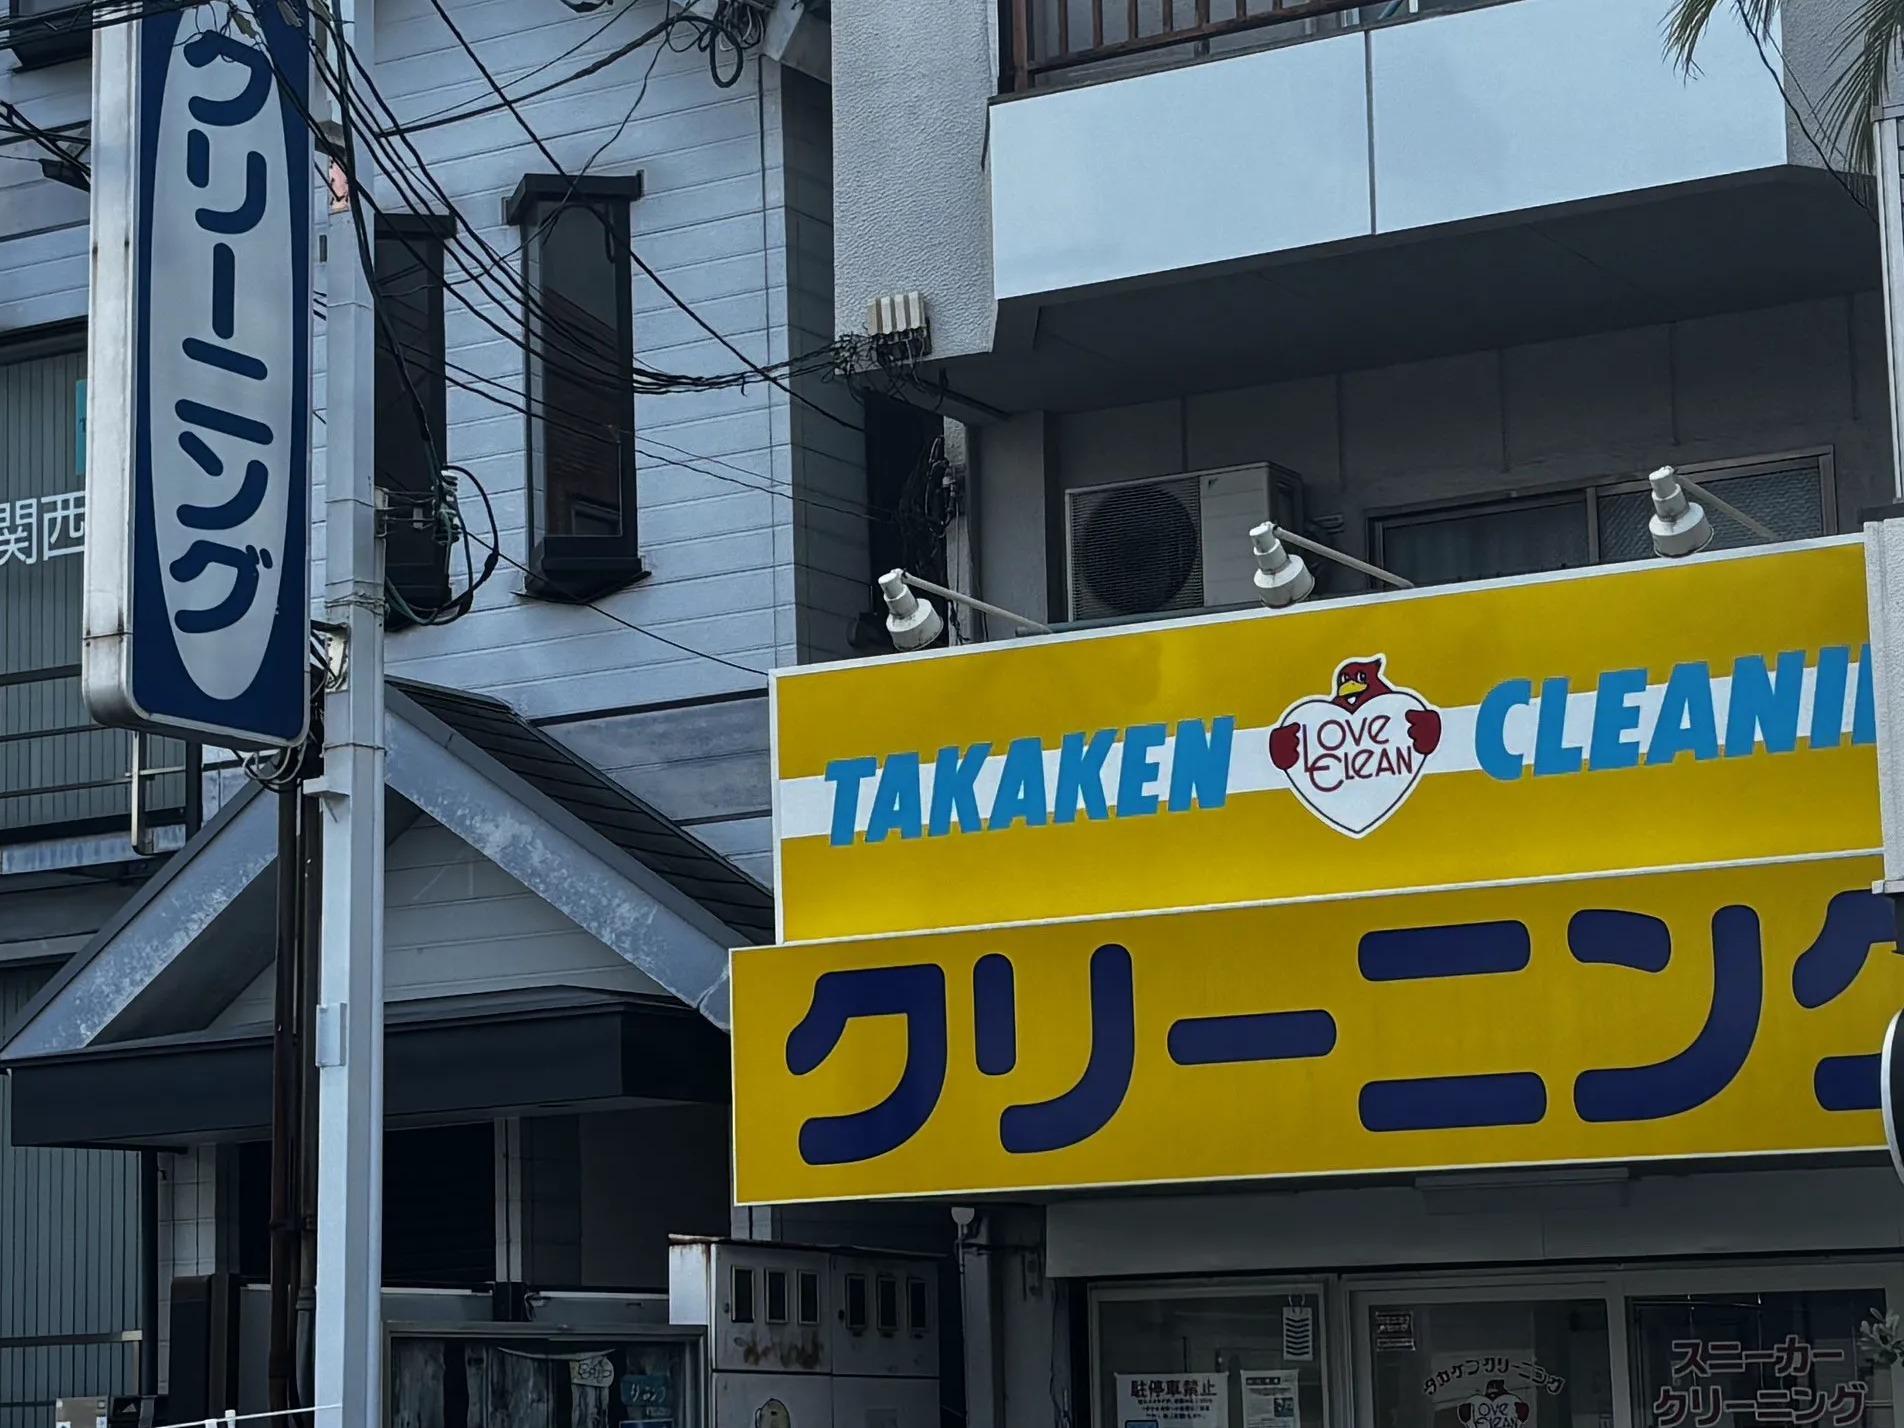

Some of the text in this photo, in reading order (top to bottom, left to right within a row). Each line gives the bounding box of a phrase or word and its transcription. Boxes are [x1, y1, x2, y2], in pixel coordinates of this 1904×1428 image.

[169, 29, 274, 635] クリーニング
[1302, 715, 1391, 772] LOVE
[1309, 744, 1413, 792] CLEAN
[825, 714, 1234, 847] TAKAKEN
[1672, 1334, 1844, 1377] スニーカー
[1654, 1382, 1867, 1427] クリーニング
